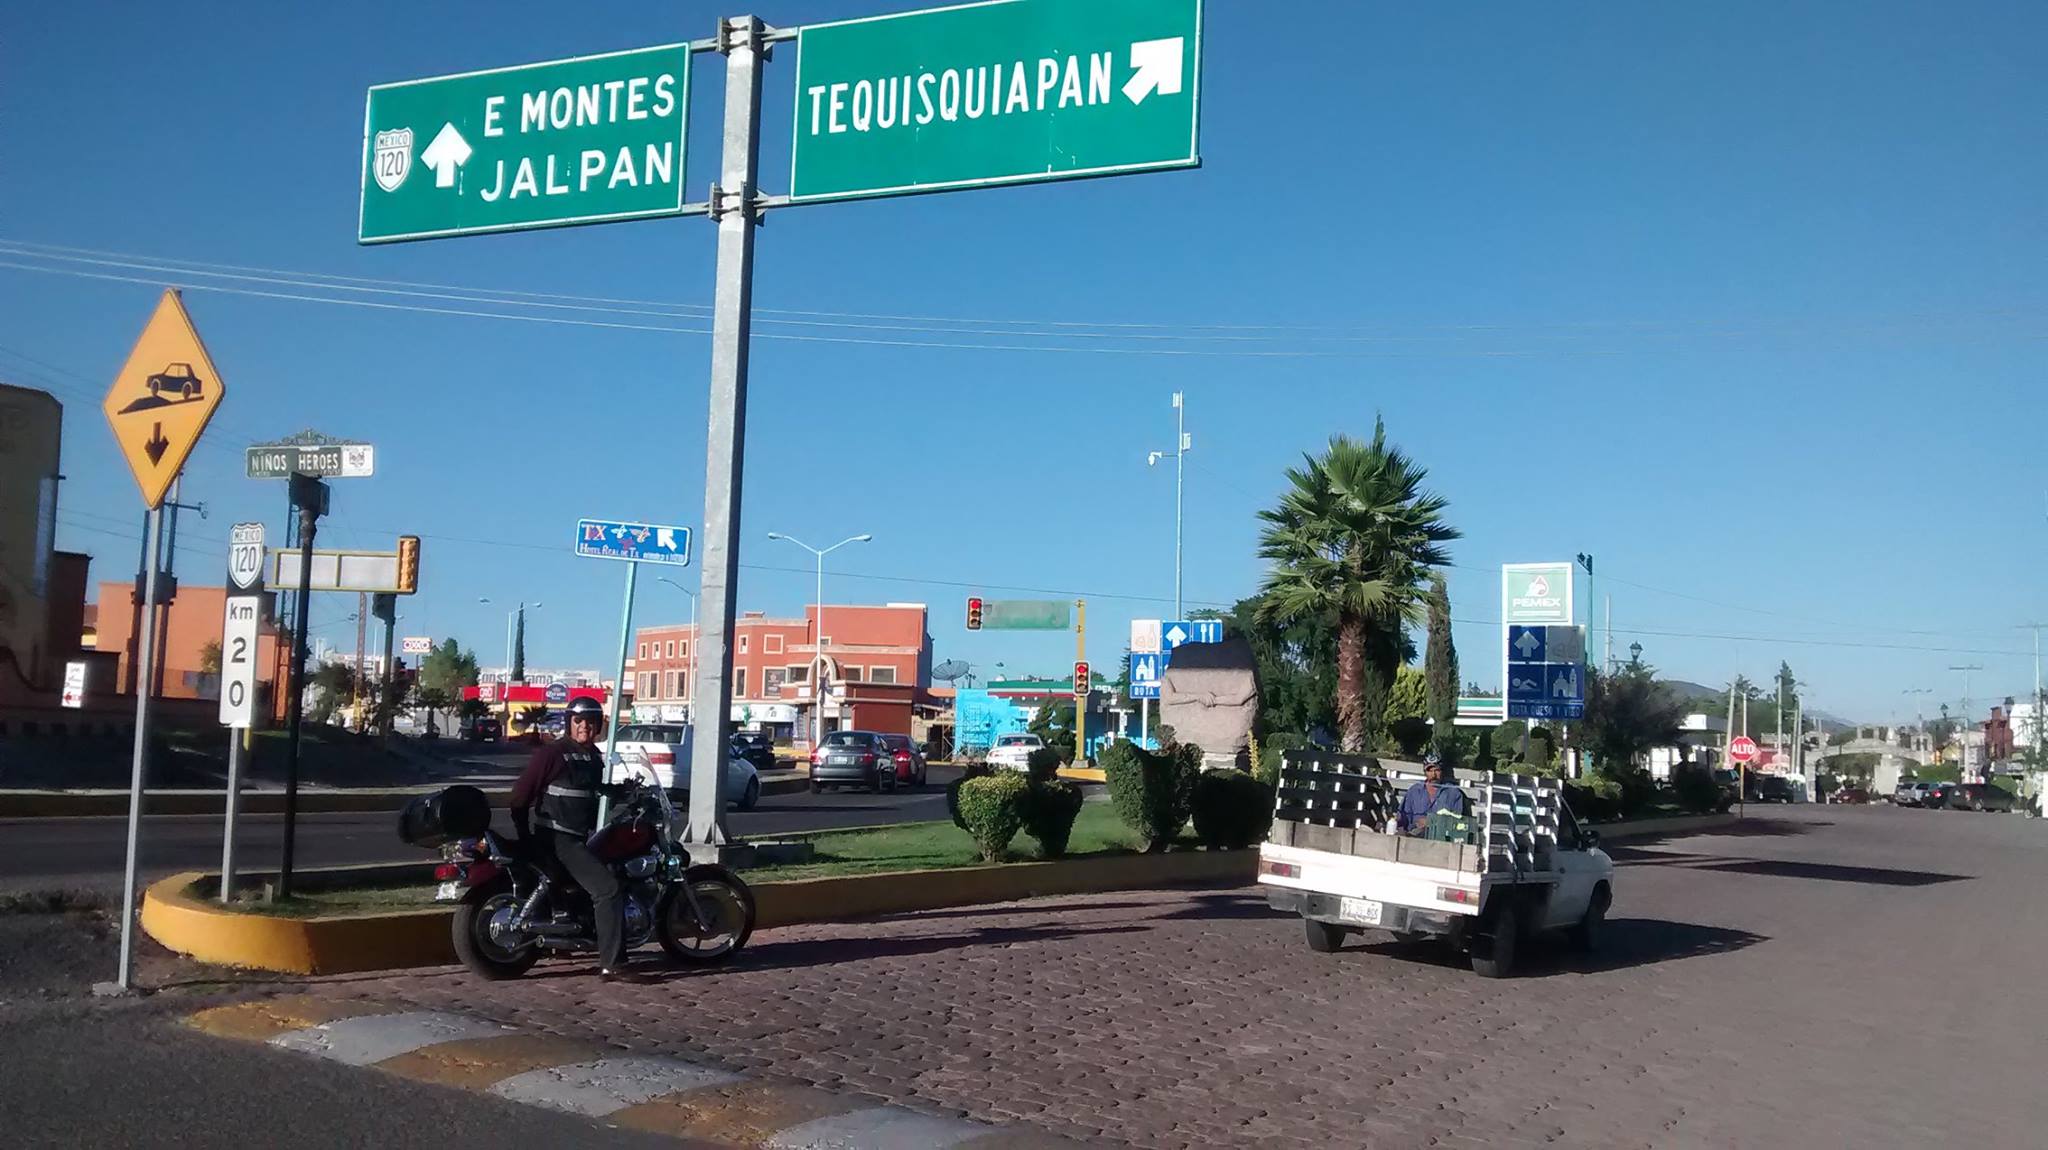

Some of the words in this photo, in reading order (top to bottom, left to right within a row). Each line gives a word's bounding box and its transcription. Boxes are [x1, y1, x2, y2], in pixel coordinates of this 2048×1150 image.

[808, 51, 1112, 136] TEQUISQUIAPAN
[484, 96, 505, 138] E
[520, 74, 676, 133] MONTES
[379, 134, 408, 147] MEXICO
[381, 150, 404, 177] 120
[480, 142, 672, 202] JALPAN
[251, 453, 287, 471] NIÑOS
[298, 453, 339, 471] HEROES
[581, 523, 607, 541] TX
[235, 546, 257, 573] 120
[229, 602, 254, 620] km
[1513, 598, 1561, 608] PEMEX
[1732, 743, 1754, 755] ALTO
